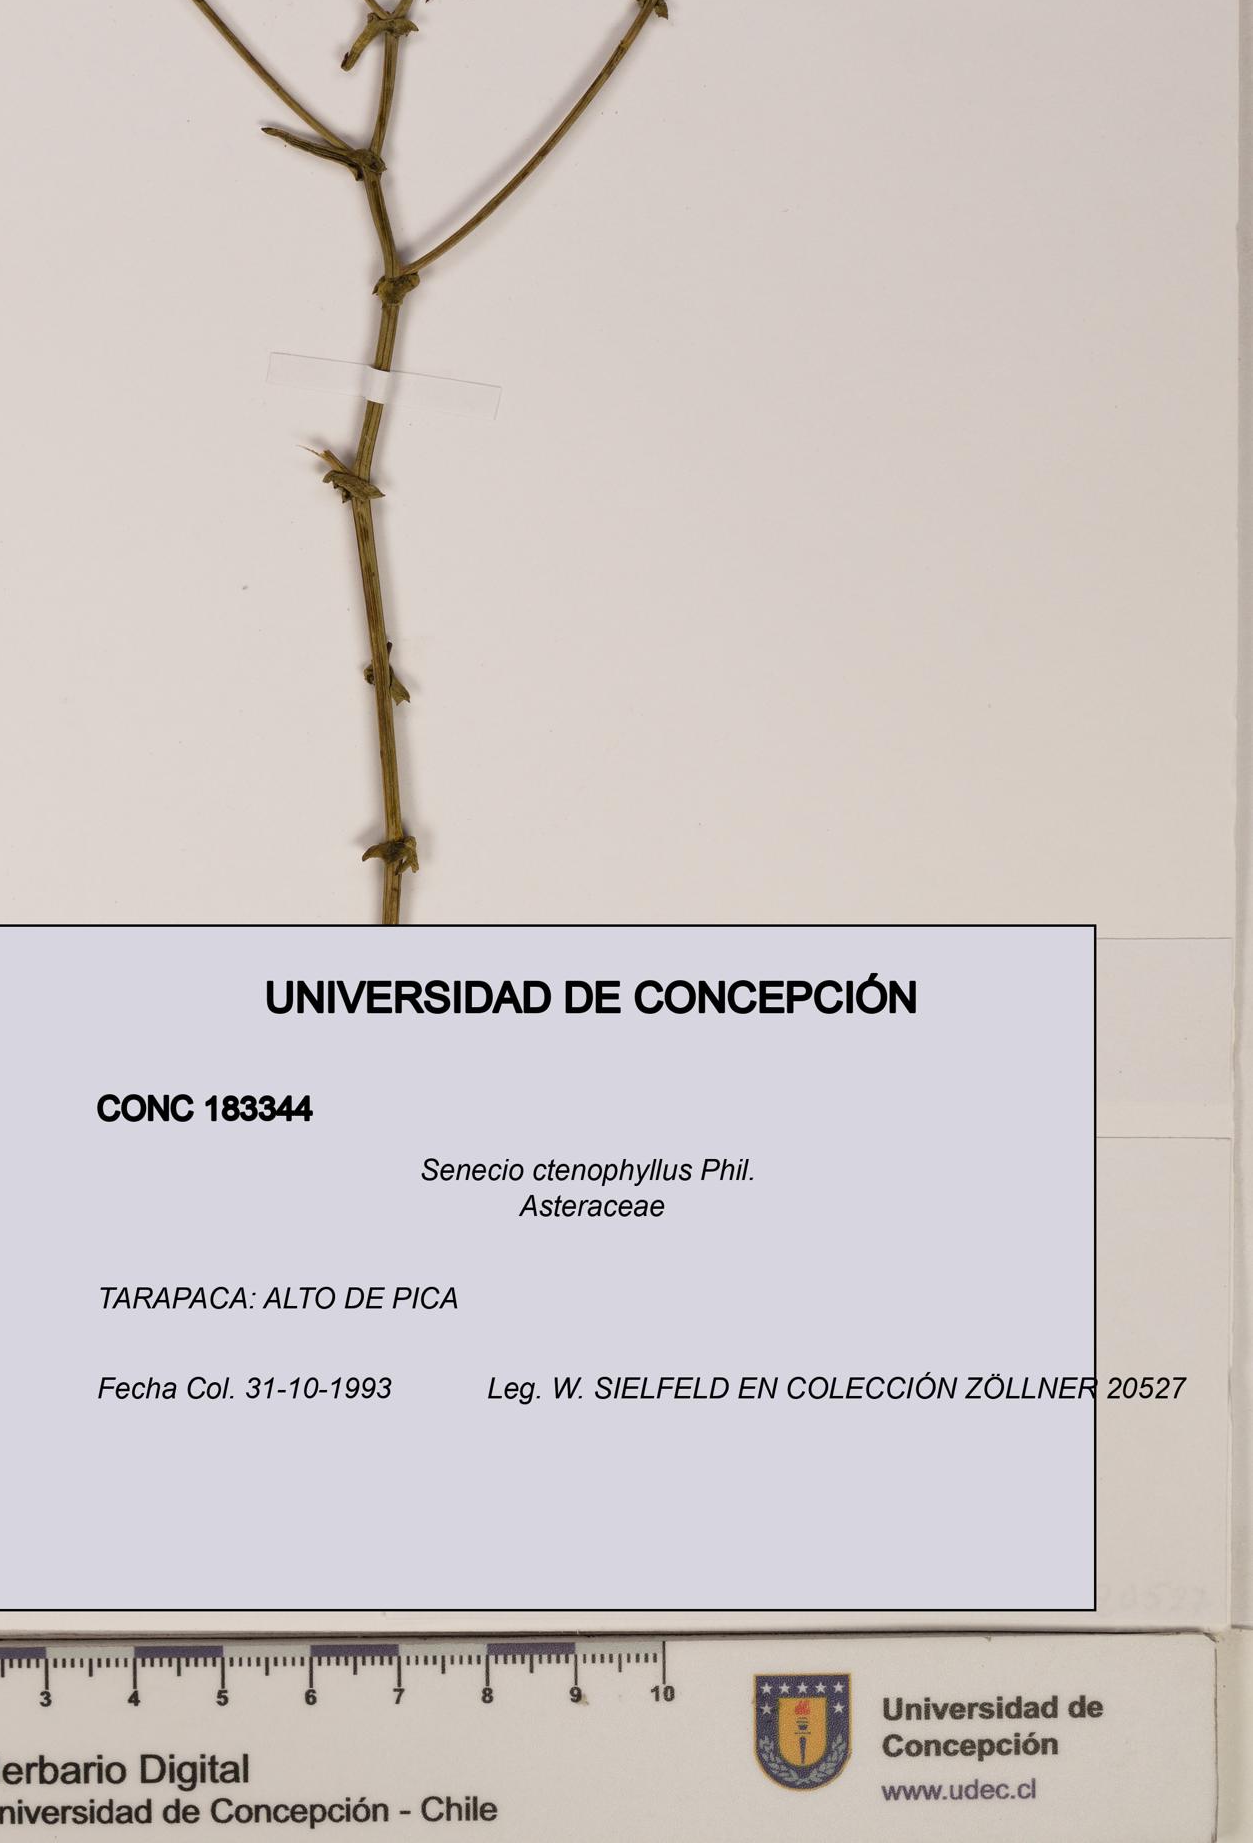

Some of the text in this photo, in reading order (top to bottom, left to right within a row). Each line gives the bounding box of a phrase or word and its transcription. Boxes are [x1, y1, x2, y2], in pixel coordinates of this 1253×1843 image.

[39, 1690, 53, 1708] 3
[127, 1689, 142, 1707] 4
[215, 1689, 230, 1707] 5
[304, 1688, 318, 1706] 6
[392, 1687, 406, 1705] 7
[480, 1687, 495, 1705] 8
[569, 1686, 583, 1703] 9
[650, 1685, 676, 1702] 10
[882, 1694, 1104, 1722] Universidad de
[881, 1731, 1059, 1762] Concepción
[139, 1753, 250, 1793] Digital
[880, 1777, 1037, 1802] www.udec.cl
[161, 1797, 201, 1825] de
[209, 1796, 390, 1830] Concepción
[420, 1795, 499, 1824] Chile
